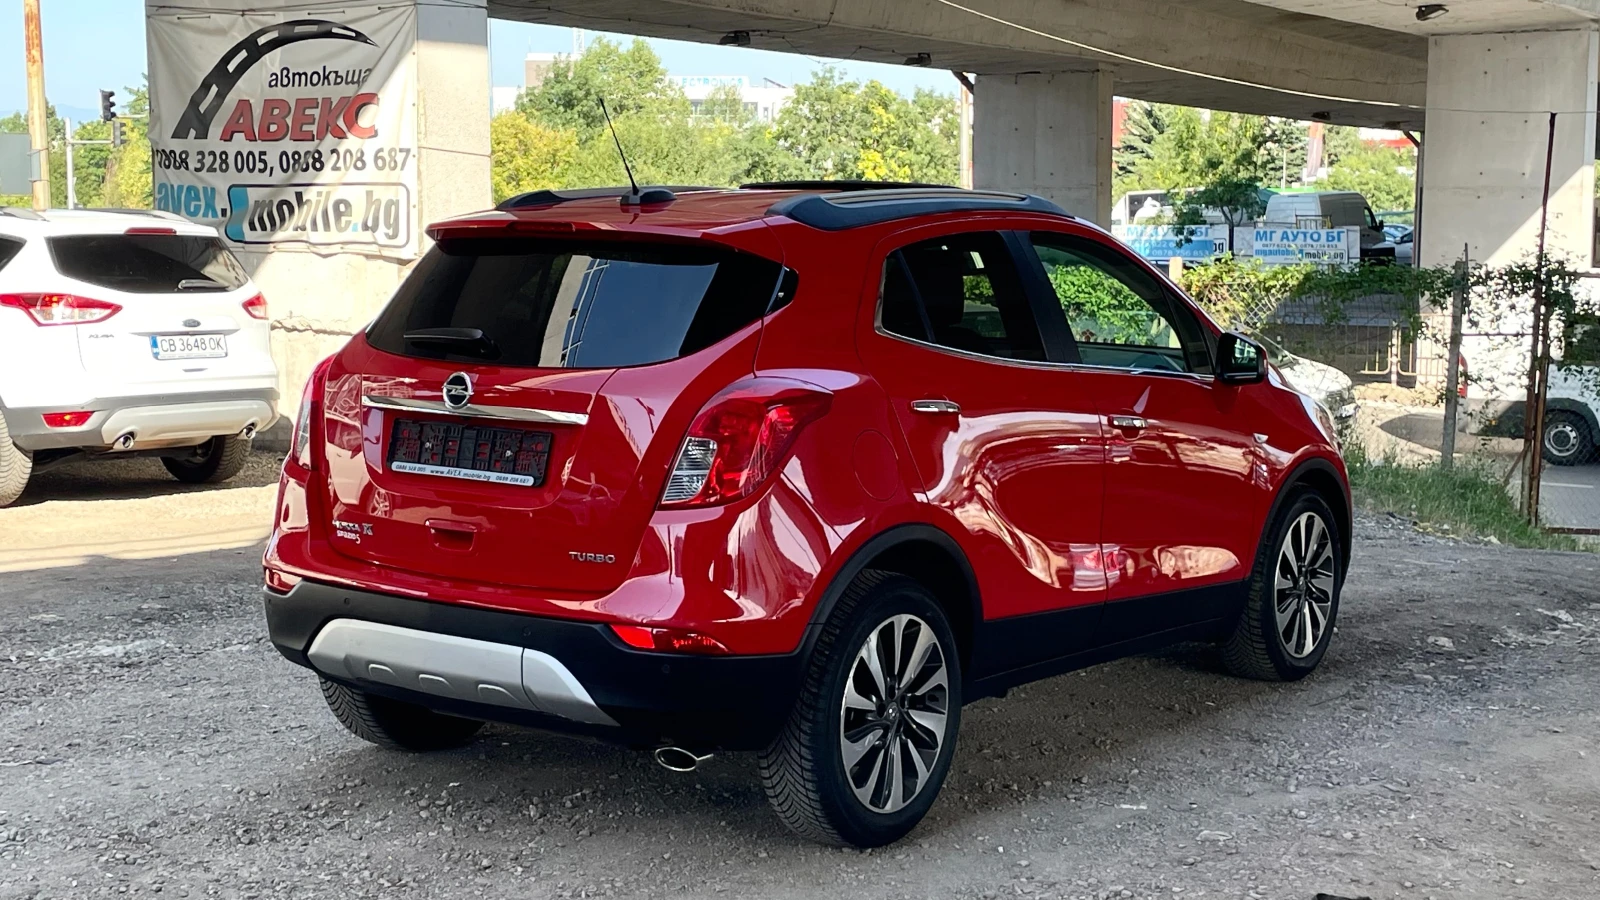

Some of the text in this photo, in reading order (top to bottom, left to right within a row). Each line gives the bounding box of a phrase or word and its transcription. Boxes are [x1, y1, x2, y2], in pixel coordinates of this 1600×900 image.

[268, 66, 373, 88] автокъща
[220, 92, 379, 142] АВЕКС
[194, 150, 229, 173] 328
[234, 150, 274, 178] 005,
[279, 148, 325, 174] 0888
[330, 147, 367, 172] 208
[373, 147, 411, 172] 687
[1255, 230, 1345, 242] МГ АУТО БГ
[160, 338, 177, 352] CB
[179, 337, 207, 352] 3648
[568, 551, 616, 564] TURBO
